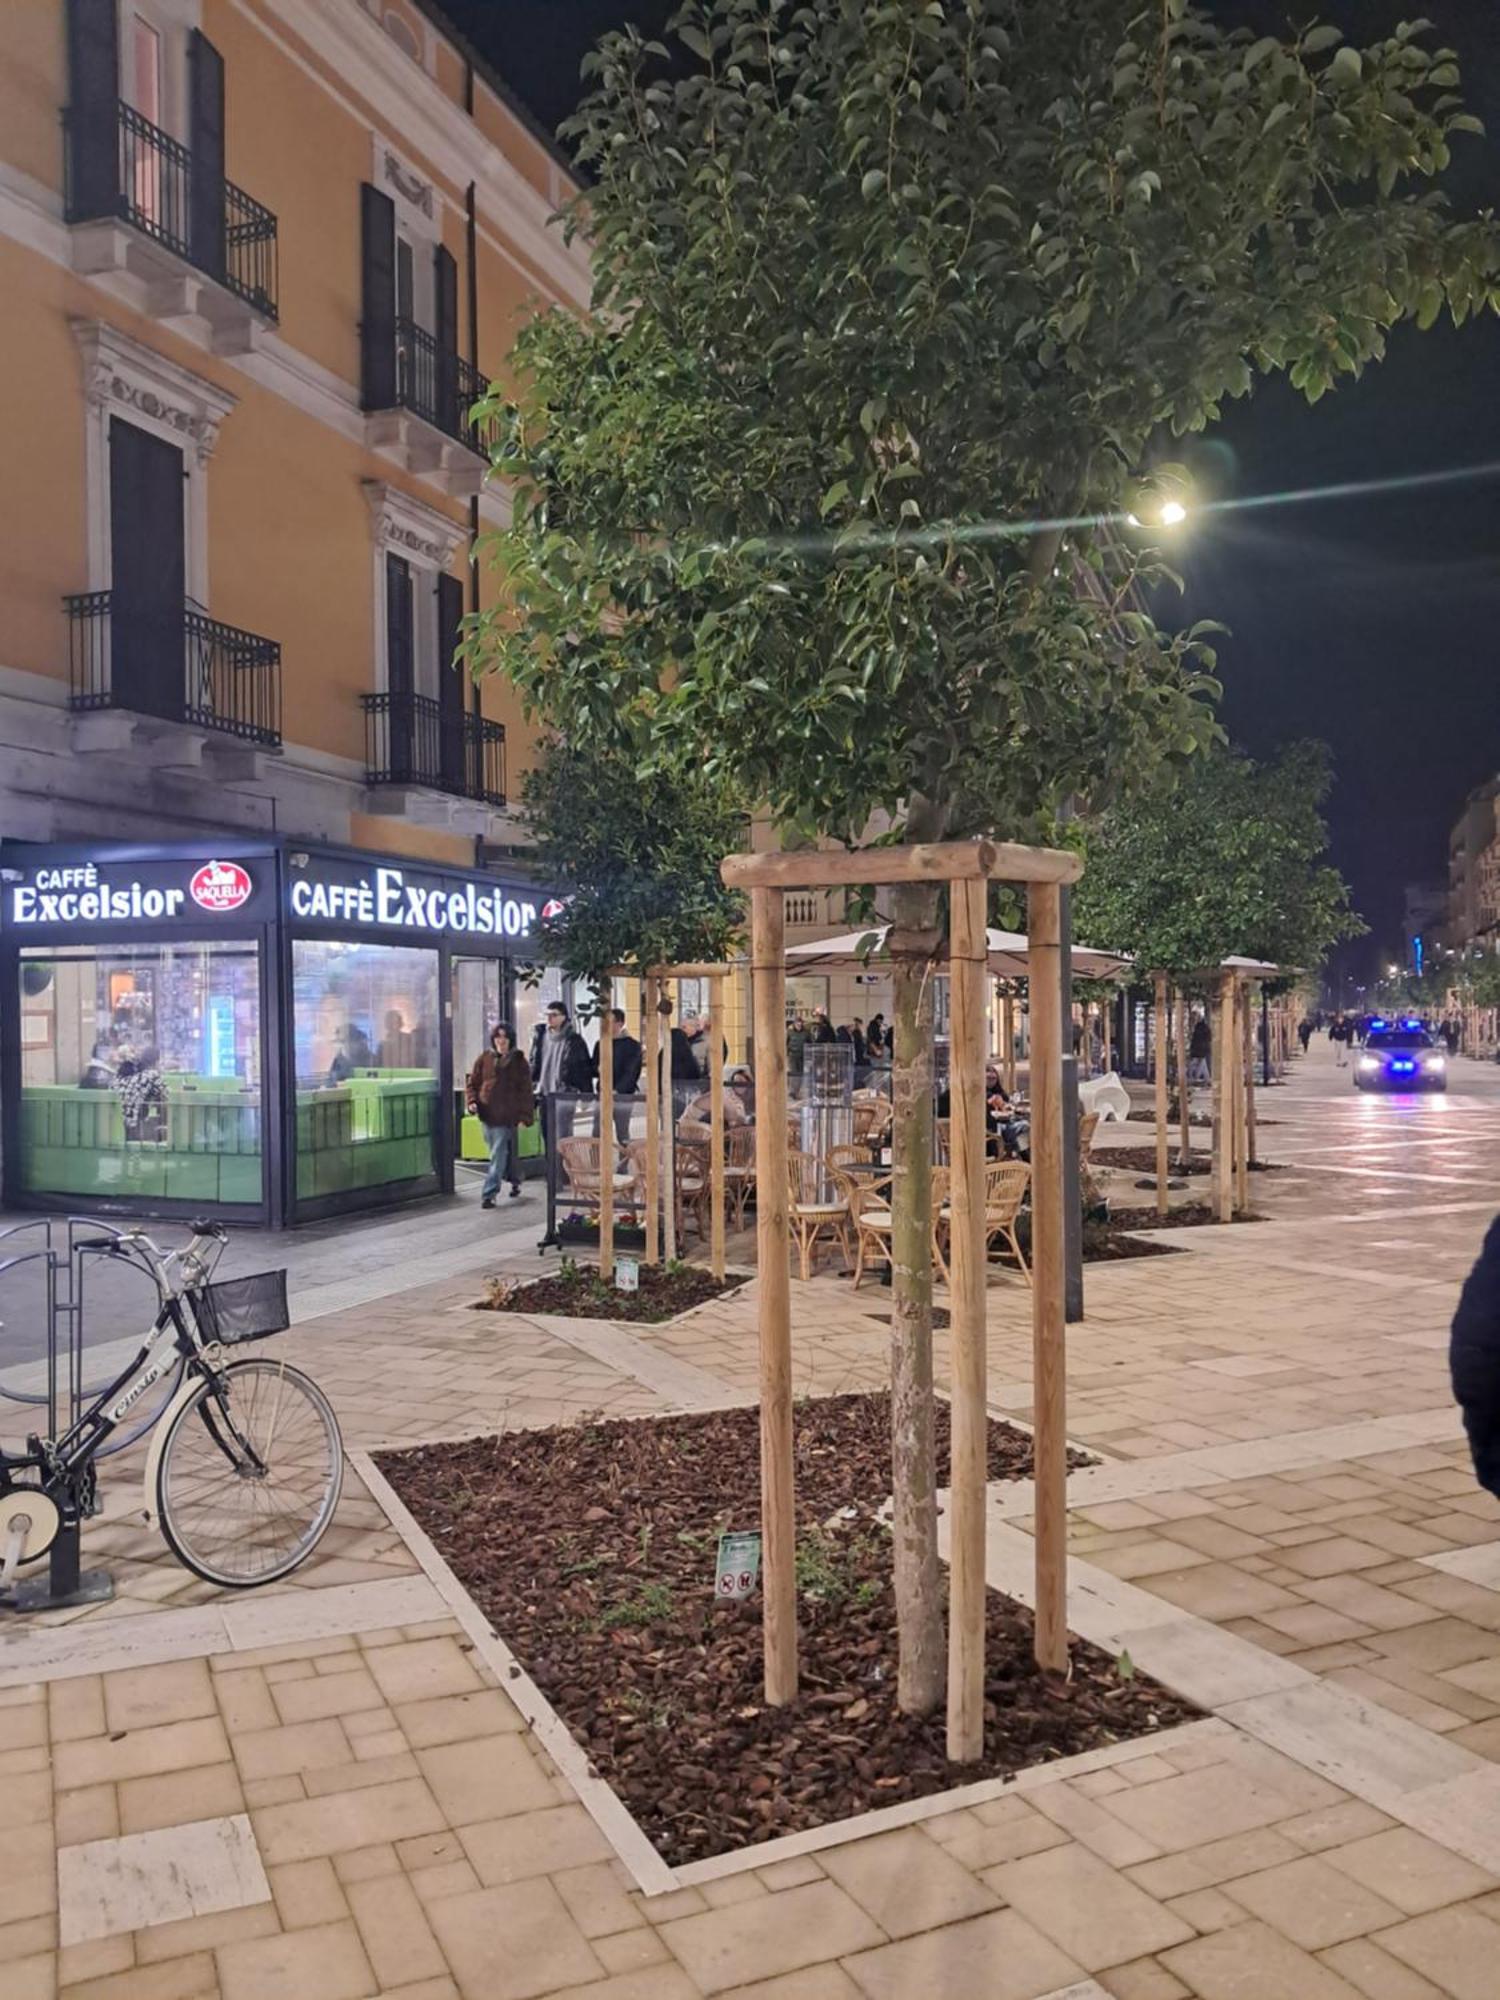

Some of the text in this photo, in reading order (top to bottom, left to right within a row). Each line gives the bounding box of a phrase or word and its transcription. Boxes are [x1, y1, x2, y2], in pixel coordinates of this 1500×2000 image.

[36, 863, 97, 890] CAFFÈ
[13, 882, 184, 922] Excelsior
[292, 868, 536, 937] CAFFÈ Excelsior
